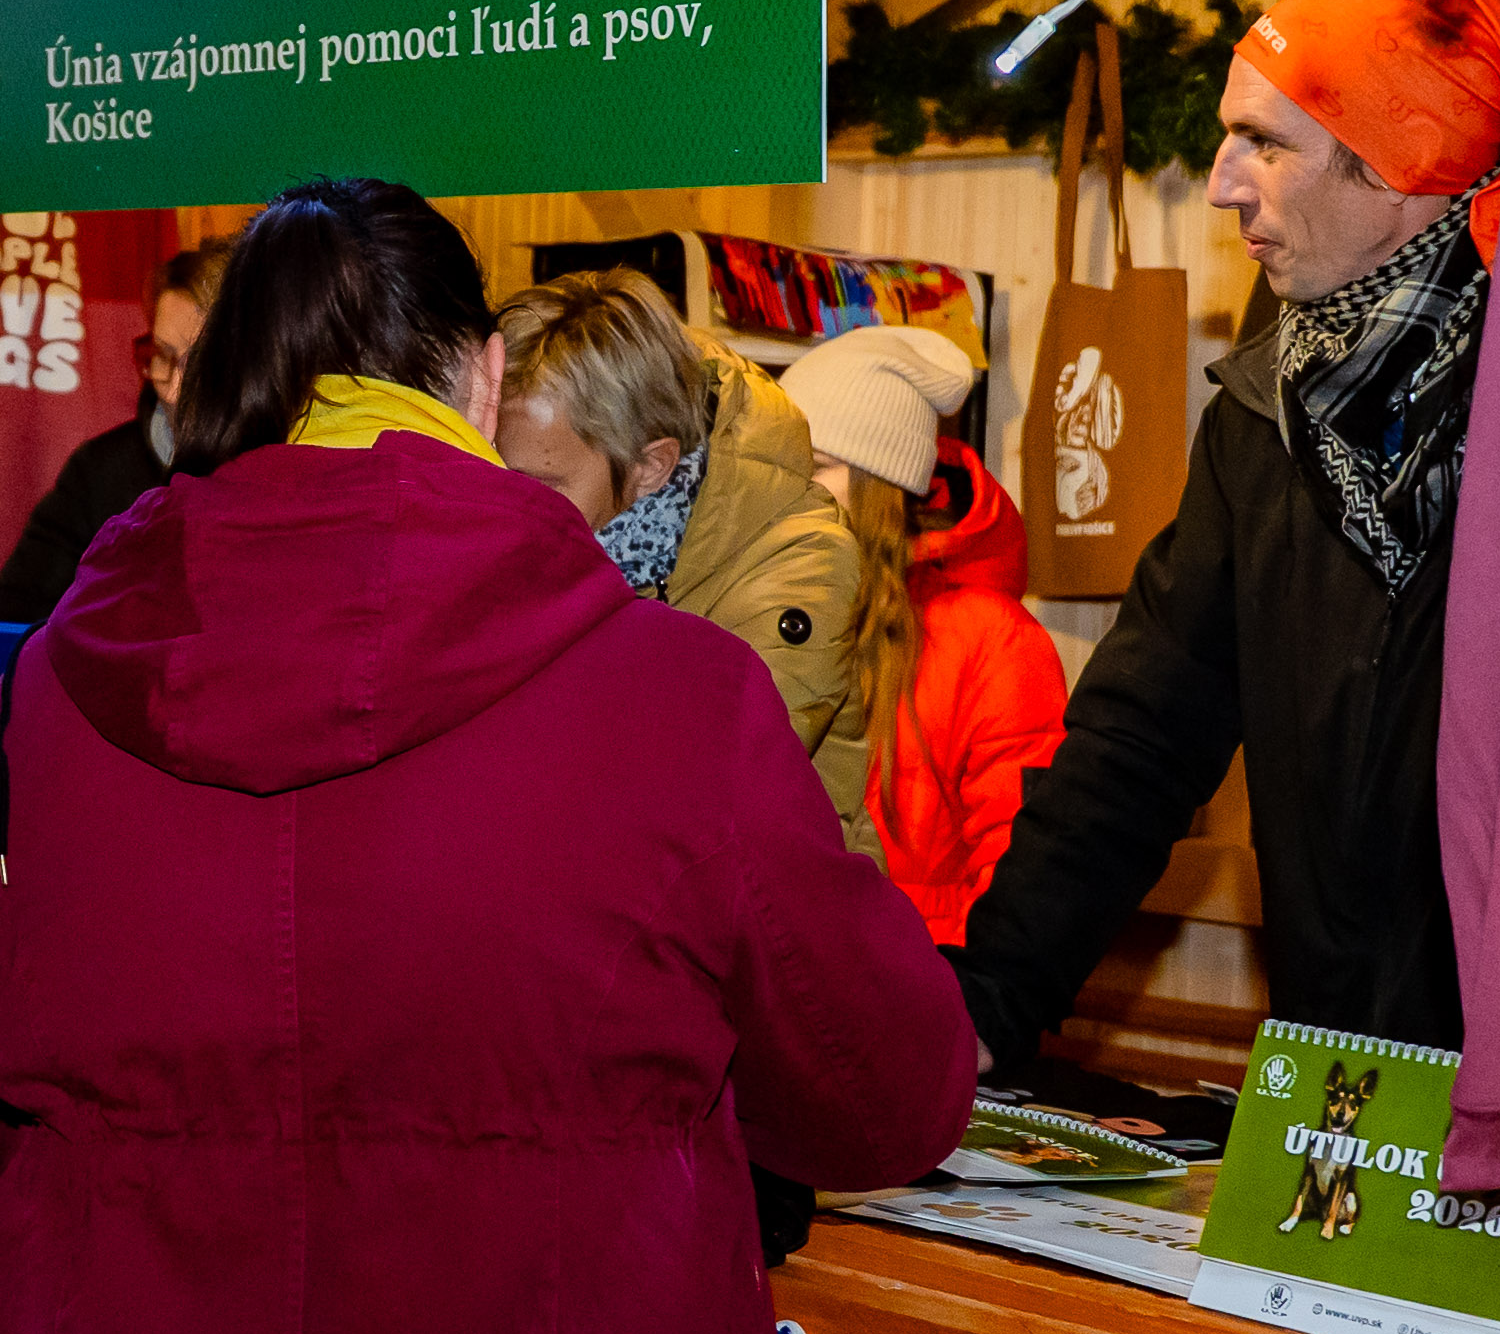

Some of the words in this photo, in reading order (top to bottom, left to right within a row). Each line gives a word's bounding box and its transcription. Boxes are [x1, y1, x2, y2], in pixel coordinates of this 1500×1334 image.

[45, 35, 123, 88] Únia
[130, 23, 306, 92] vzájomnej
[318, 10, 459, 83] pomoci
[471, 0, 557, 55] ľudí
[569, 13, 591, 47] a
[602, 2, 713, 61] psov,
[45, 97, 152, 144] Košice
[1284, 1122, 1429, 1180] ÚTULOK
[1325, 1307, 1383, 1329] www.uvp.sk
